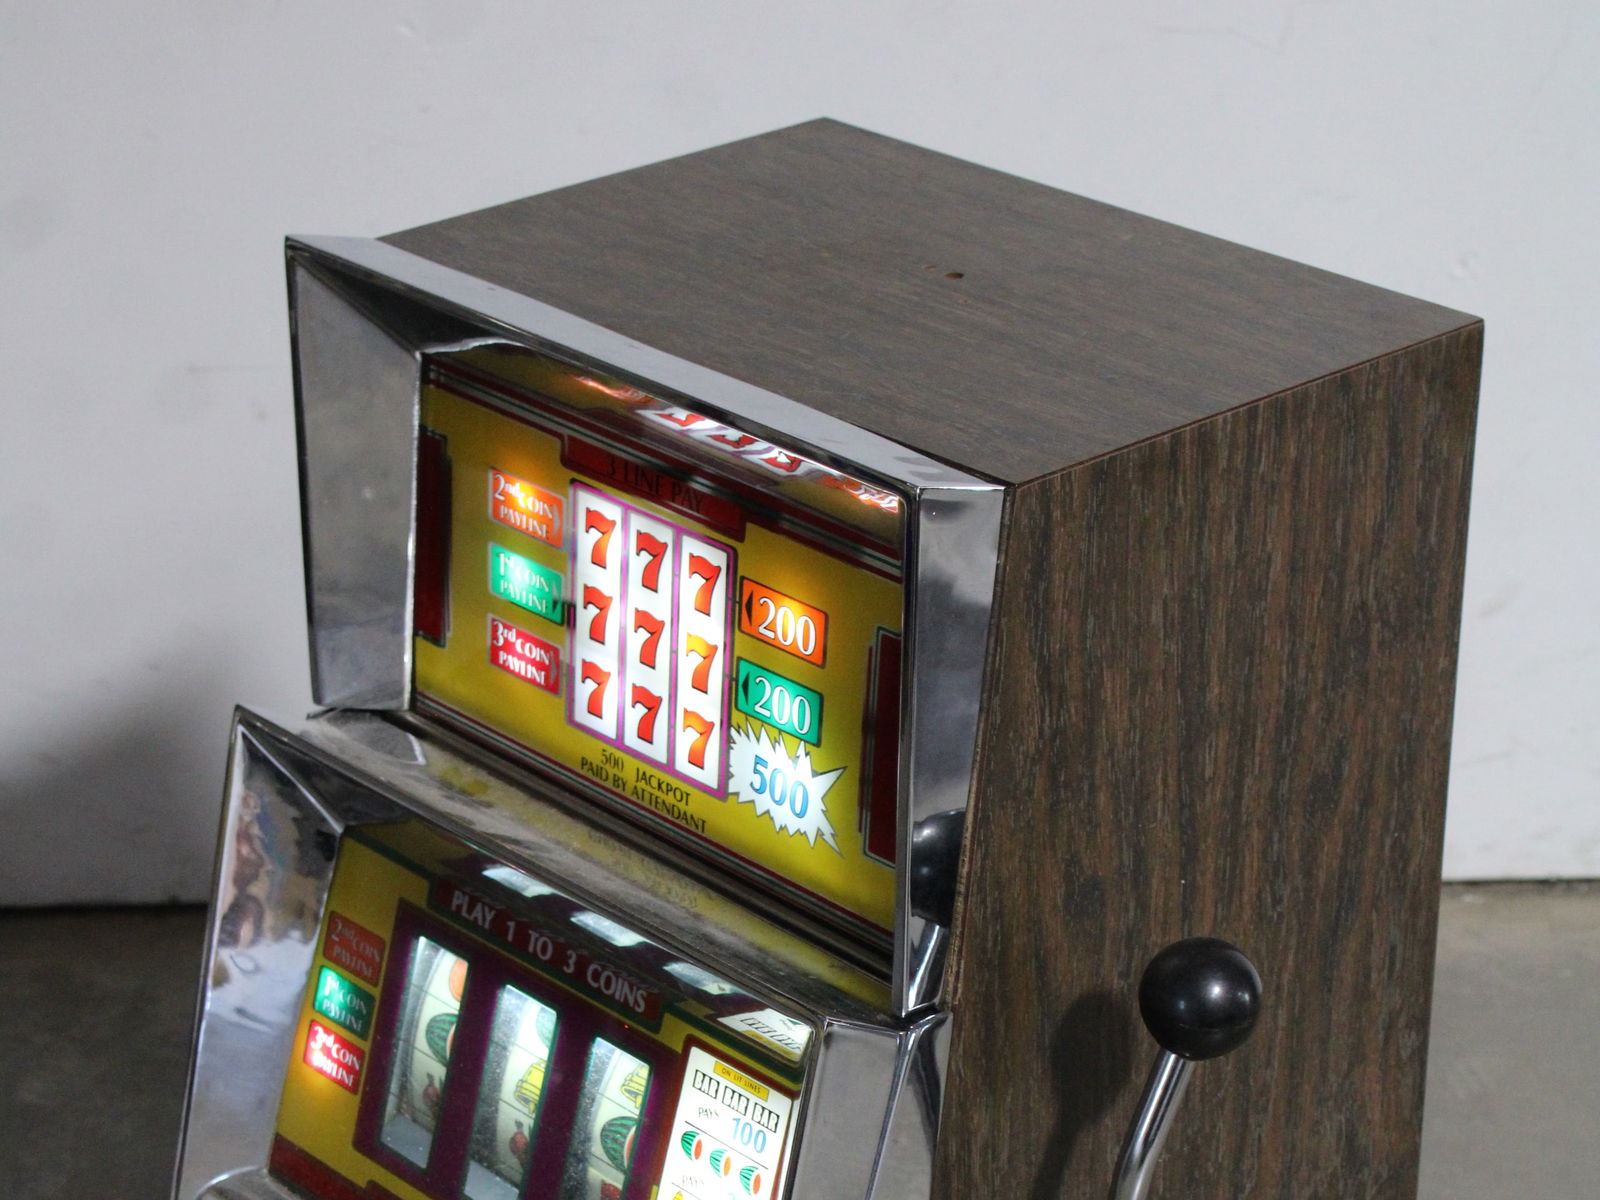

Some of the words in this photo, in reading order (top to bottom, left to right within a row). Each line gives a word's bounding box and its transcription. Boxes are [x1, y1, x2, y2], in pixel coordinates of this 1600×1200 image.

[501, 504, 548, 539] PAYLINE
[518, 492, 553, 519] COIN
[585, 507, 617, 569] 7
[636, 530, 669, 592] 7
[688, 553, 721, 617] 7
[500, 579, 547, 613] PAYLINE
[515, 638, 550, 666] COIN
[583, 584, 613, 645] 7
[633, 608, 665, 669] 7
[686, 633, 719, 694] 7
[758, 597, 817, 656] 200
[499, 651, 547, 686] PAYLINE
[581, 659, 611, 719] 7
[631, 683, 663, 744] 7
[682, 708, 715, 770] 7
[753, 676, 812, 735] 200
[580, 756, 609, 782] PAID
[612, 773, 628, 793] BY
[631, 785, 707, 834] ATTENDANT
[601, 748, 625, 773] 500
[635, 767, 691, 806] JACKPOT
[750, 754, 810, 820] 500
[451, 890, 497, 930] PLAY
[506, 920, 516, 942] 1
[528, 930, 553, 961] TO
[563, 950, 577, 974] 3
[586, 964, 648, 1014] COINS
[331, 1043, 360, 1071] COIN
[692, 1069, 720, 1100] BAR
[721, 1085, 750, 1117] BAR
[751, 1102, 780, 1134] BAR
[732, 1117, 767, 1154] 100
